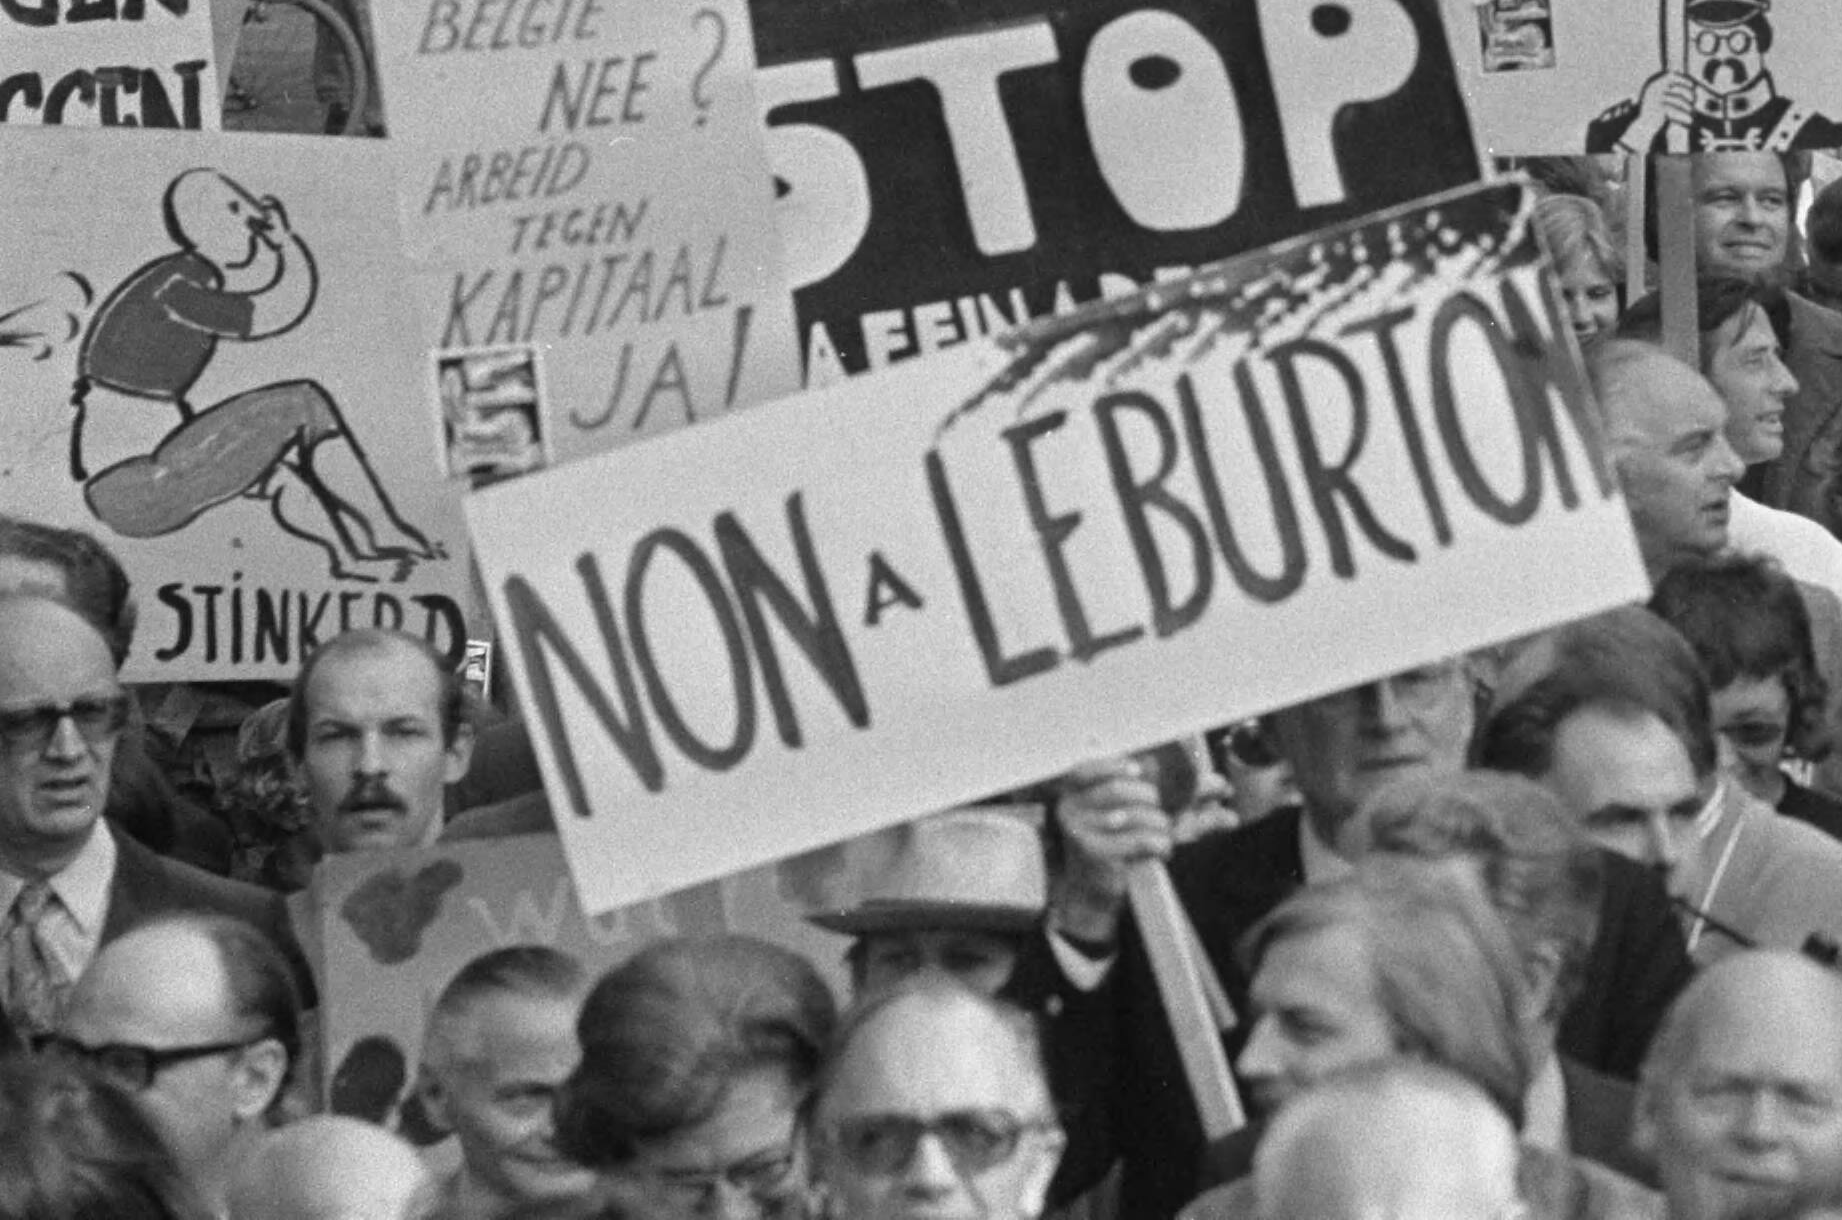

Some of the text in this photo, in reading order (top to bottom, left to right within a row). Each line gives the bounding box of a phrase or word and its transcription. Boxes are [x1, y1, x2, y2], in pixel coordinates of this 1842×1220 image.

[538, 52, 657, 134] NEE
[423, 141, 592, 214] ARBEID
[510, 198, 648, 252] TEGEN
[441, 234, 731, 348] KAPITAAL
[503, 262, 1617, 818] NON A LEBURTON
